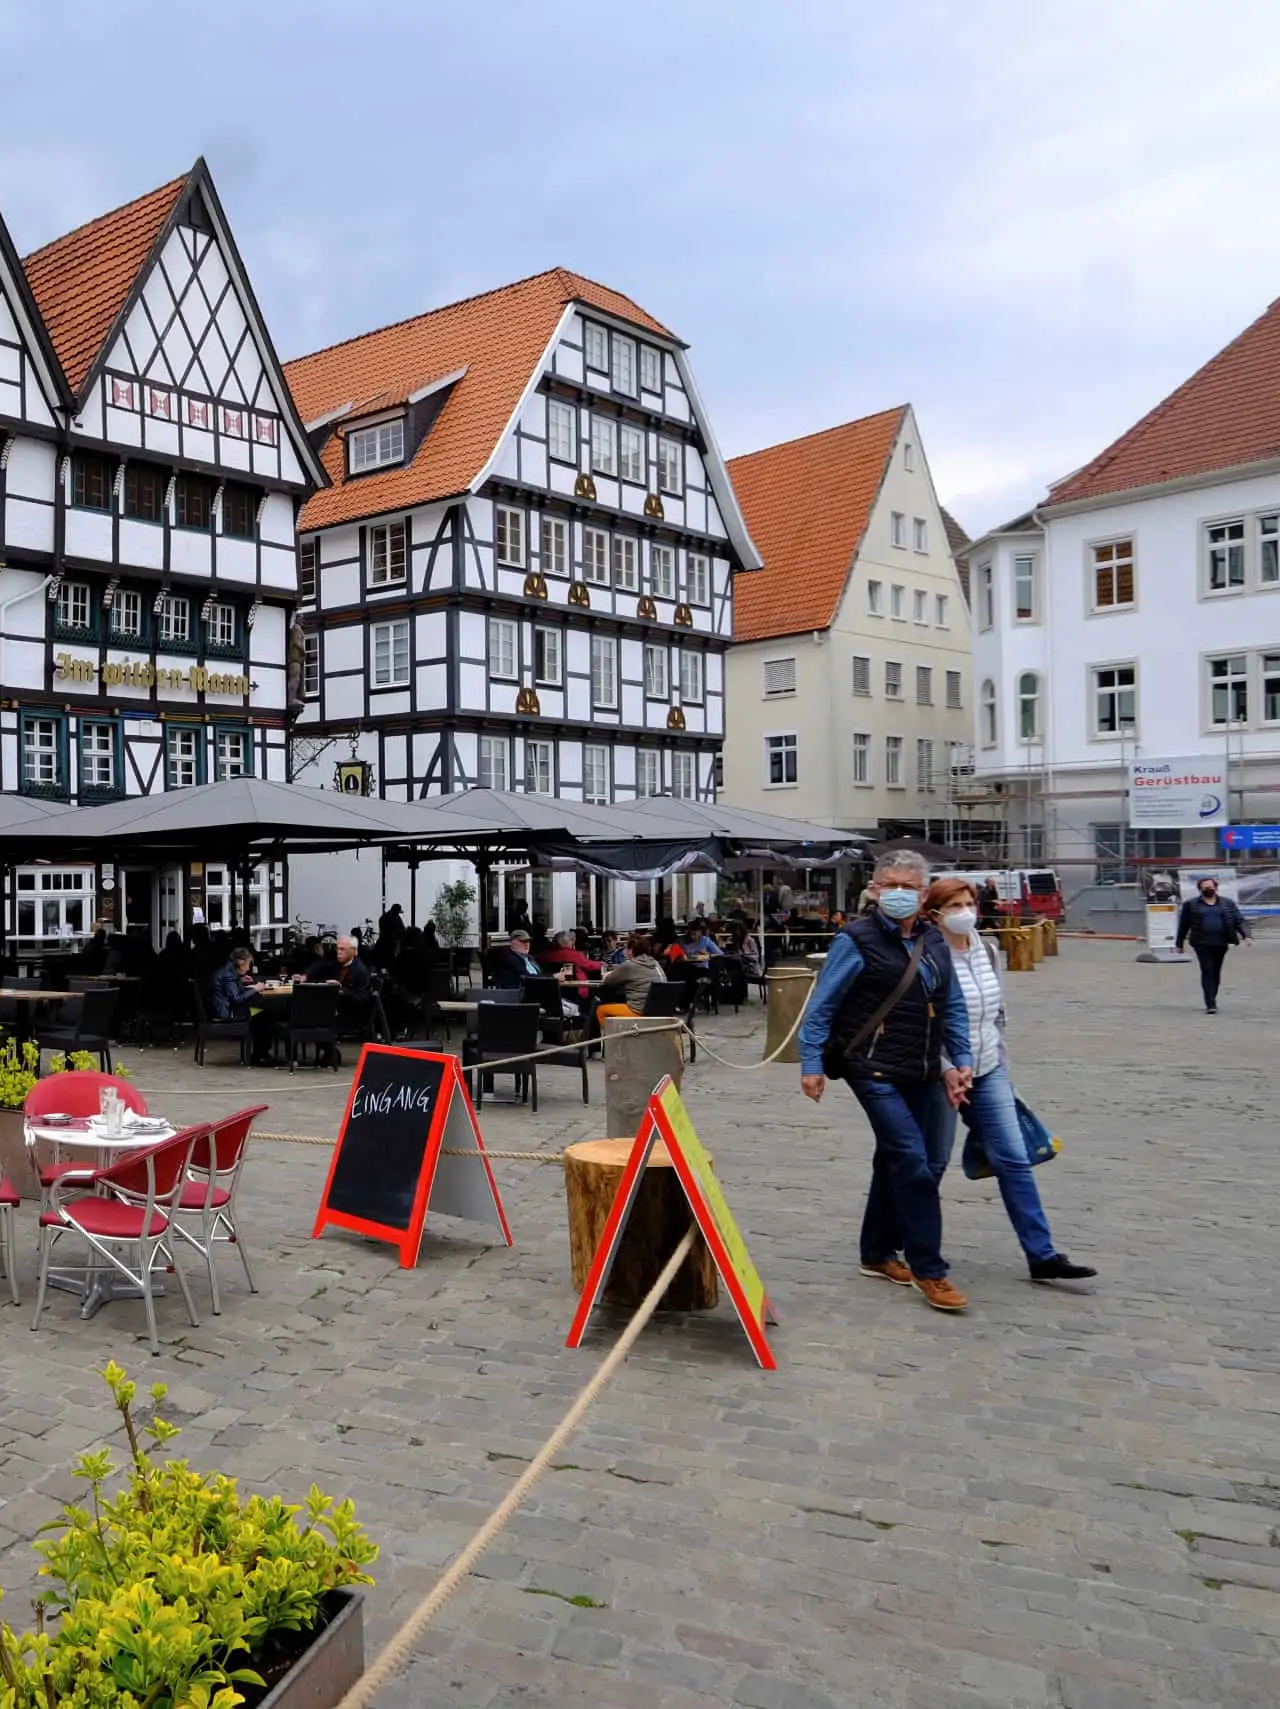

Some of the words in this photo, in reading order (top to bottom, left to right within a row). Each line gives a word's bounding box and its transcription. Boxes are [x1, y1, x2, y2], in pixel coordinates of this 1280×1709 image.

[188, 665, 249, 696] Mann
[1133, 764, 1171, 775] Krauß
[1133, 774, 1223, 787] Gerüstbau
[351, 1082, 432, 1119] EINGANG
